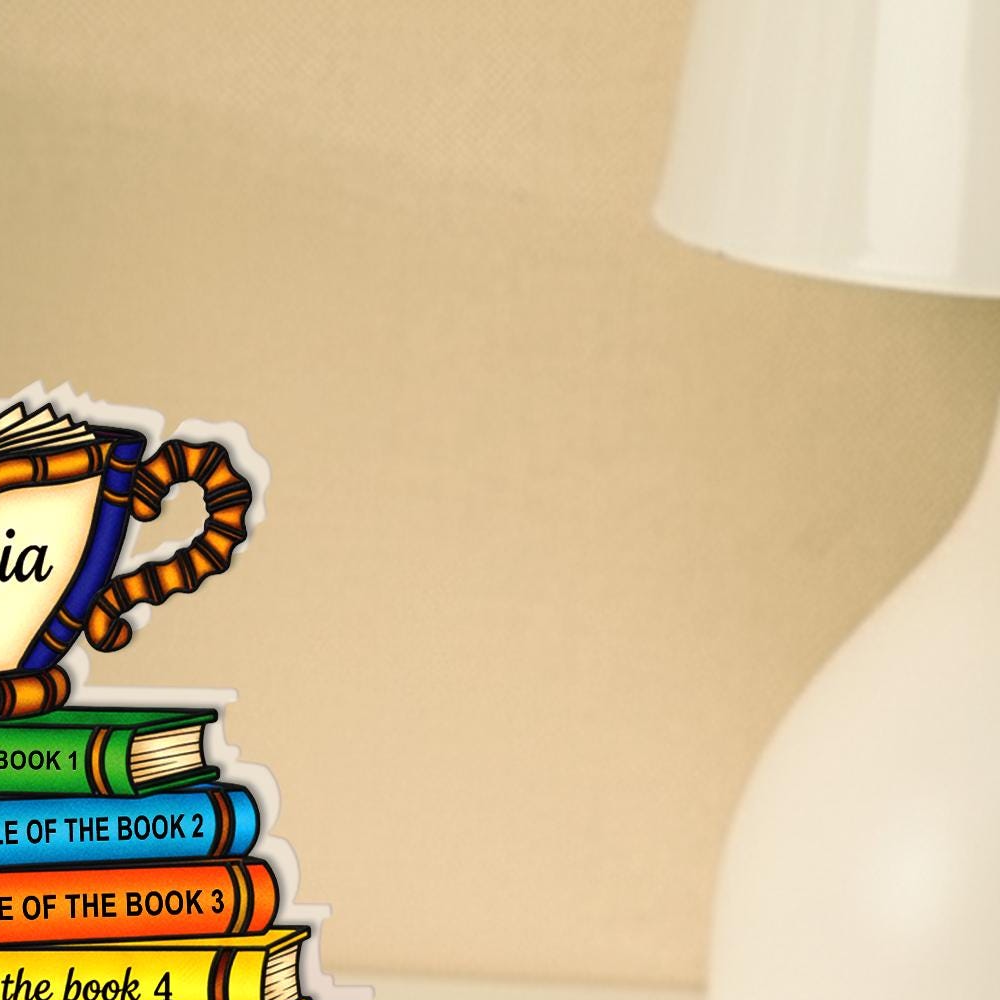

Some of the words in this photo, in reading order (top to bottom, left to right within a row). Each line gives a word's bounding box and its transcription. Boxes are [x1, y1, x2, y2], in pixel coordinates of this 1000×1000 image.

[68, 750, 78, 771] 1
[26, 818, 57, 845] OF
[64, 816, 110, 842] THE
[117, 814, 186, 841] BOOK
[192, 813, 204, 839] 2
[22, 894, 57, 921] OF
[65, 893, 117, 919] THE
[126, 890, 204, 917] BOOK
[211, 888, 225, 914] 3
